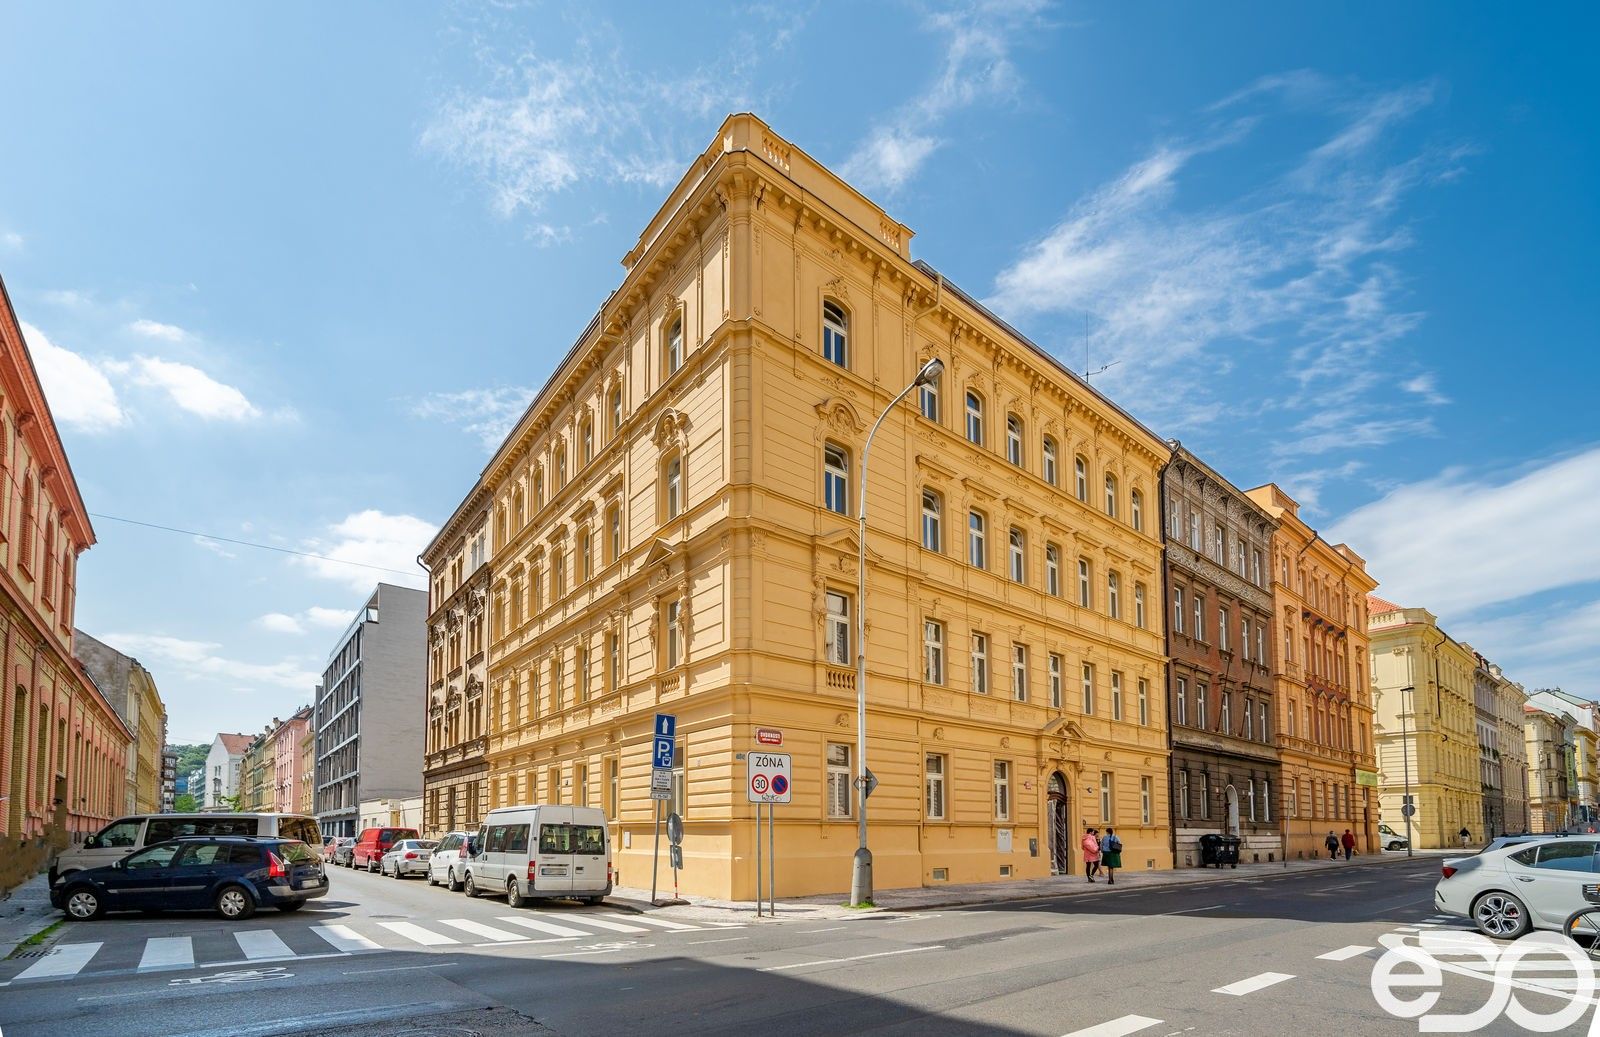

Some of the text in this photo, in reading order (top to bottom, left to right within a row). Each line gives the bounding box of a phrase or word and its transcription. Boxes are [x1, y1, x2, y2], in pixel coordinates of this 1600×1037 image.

[658, 741, 670, 759] P
[756, 755, 784, 768] ZÓNA
[755, 779, 766, 789] 30
